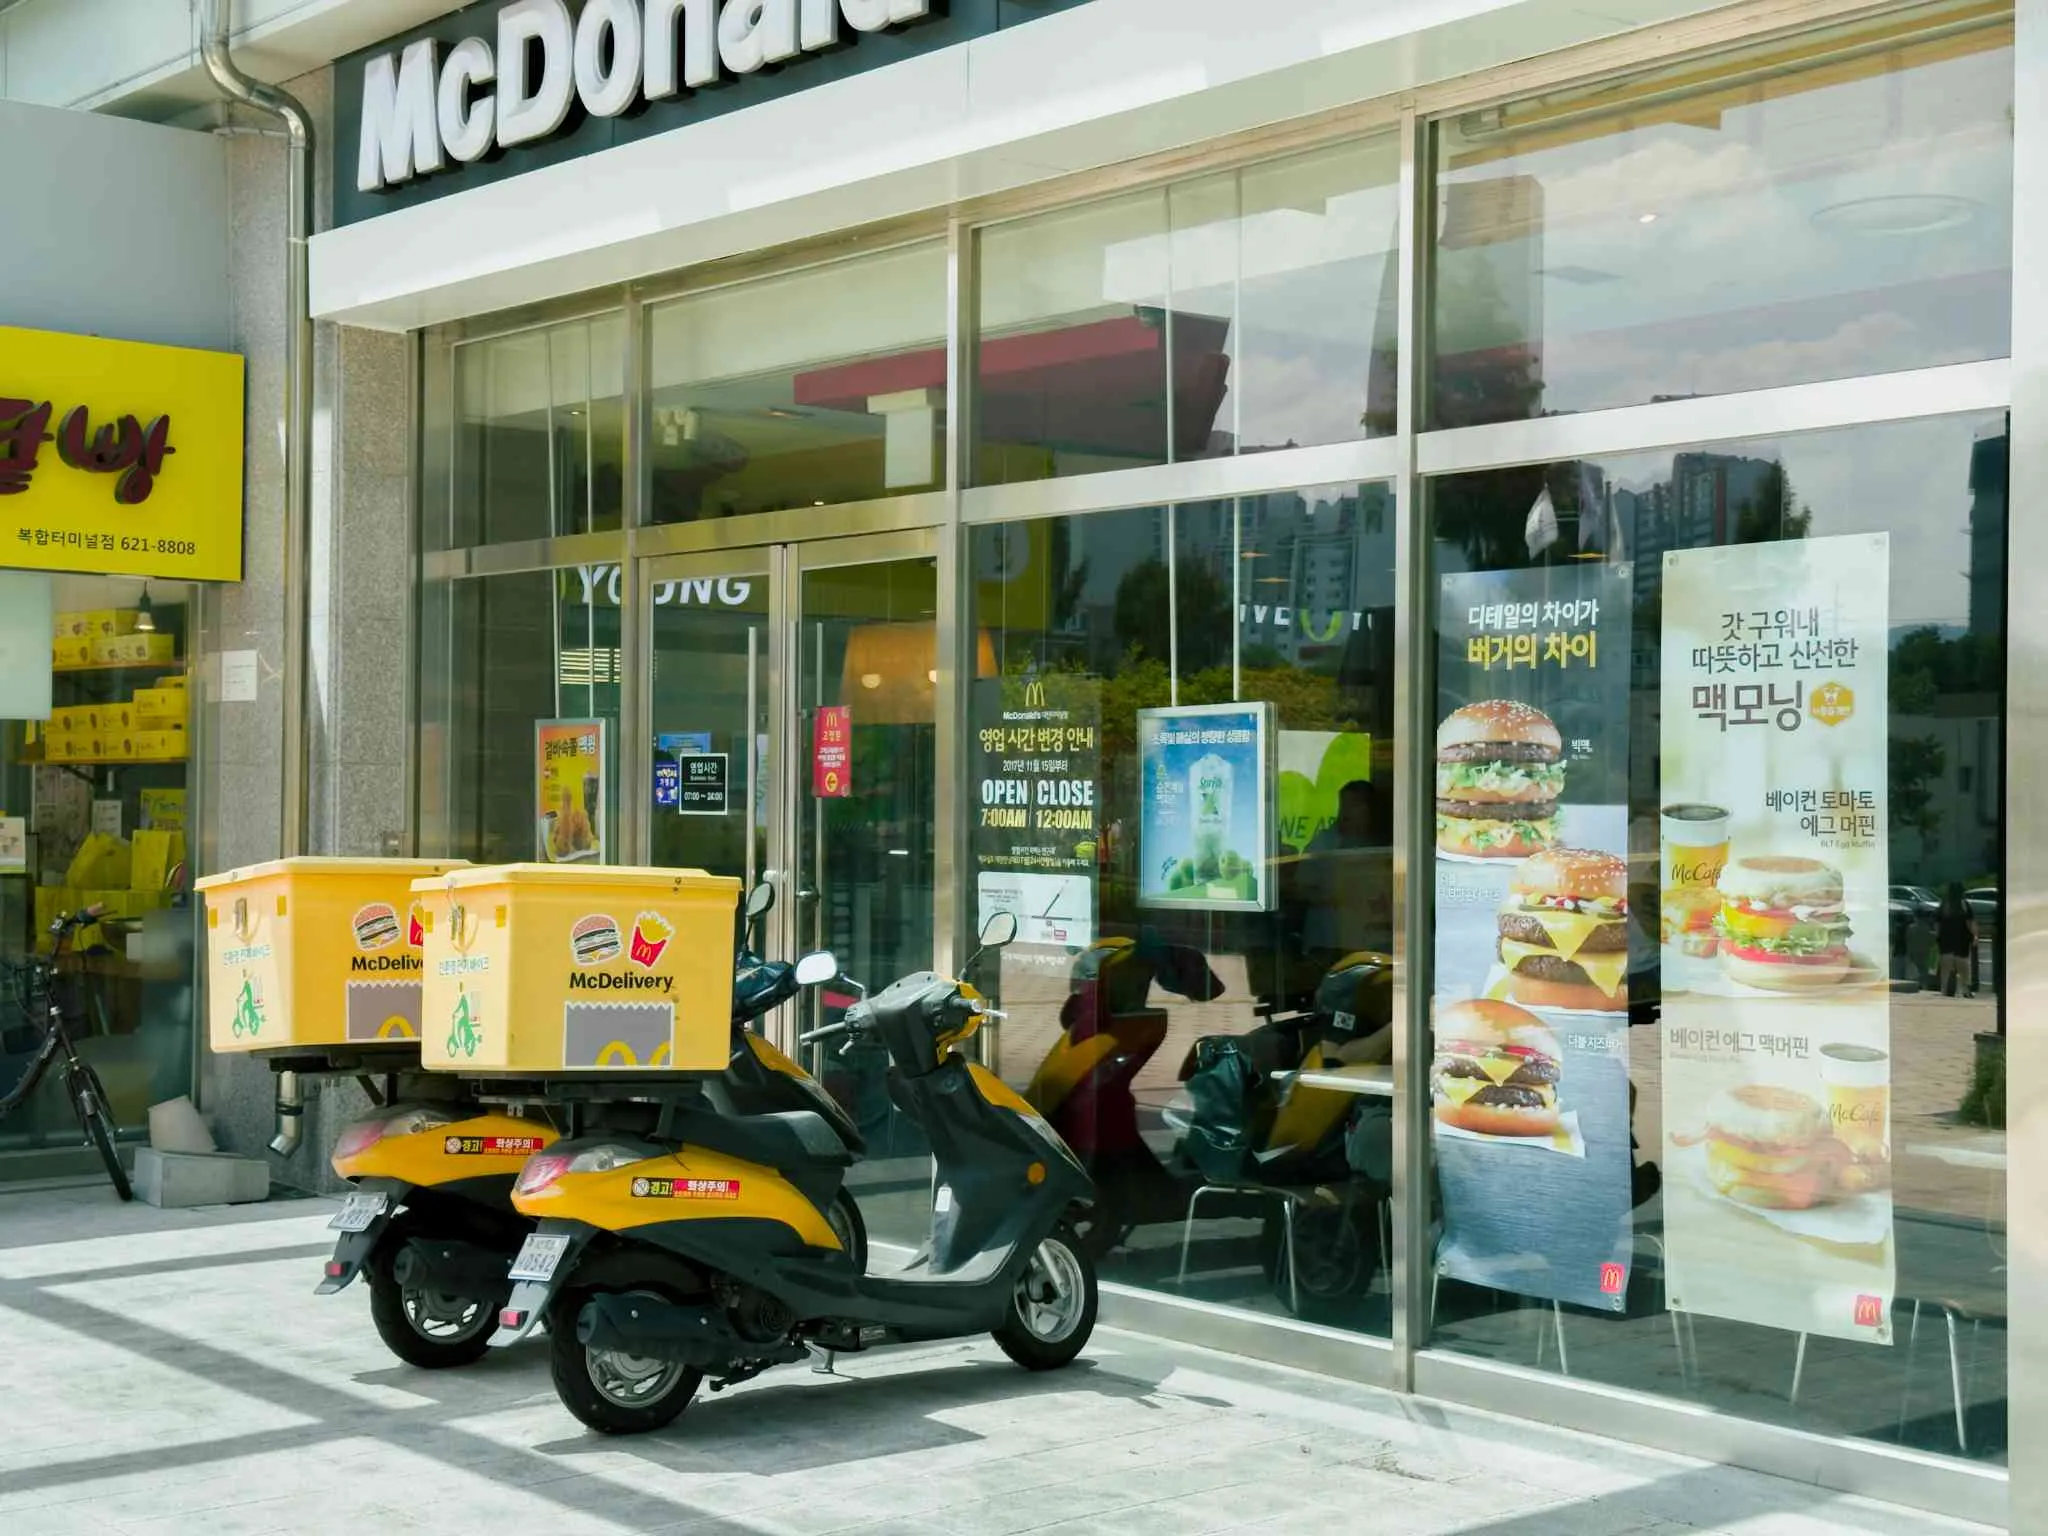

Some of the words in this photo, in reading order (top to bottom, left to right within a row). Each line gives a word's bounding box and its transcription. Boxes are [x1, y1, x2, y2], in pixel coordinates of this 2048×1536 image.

[358, 0, 932, 192] McDona
[17, 527, 115, 550] 복합터미널점
[120, 535, 196, 555] 621-8808
[1468, 601, 1539, 630] 디테일의
[1541, 598, 1600, 628] 차이가
[1721, 611, 1745, 642] 갓
[1748, 605, 1819, 640] 구워내
[1467, 633, 1537, 671] 버거의
[1543, 630, 1597, 669] 차이
[1692, 642, 1783, 674] 따뜻하고
[1789, 637, 1859, 670] 신선한
[1692, 680, 1803, 732] 맥모닝
[979, 727, 1005, 753] 영업
[1008, 727, 1035, 752] 시간
[1037, 727, 1064, 753] 변경
[1067, 727, 1094, 752] 안내
[981, 779, 1028, 805] OPEN
[1037, 779, 1094, 806] CLOSE
[1765, 789, 1817, 812] 베이컨
[1819, 789, 1876, 812] 토마토
[981, 808, 1027, 828] 7:00AM
[1036, 809, 1093, 830] 12:00AM
[1800, 814, 1836, 837] 에그
[1840, 814, 1875, 837] 머핀
[351, 955, 423, 972] McDeliv
[569, 972, 674, 993] McDelivery
[1670, 1028, 1720, 1051] 베이컨
[1723, 1030, 1756, 1053] 에그
[1758, 1033, 1810, 1060] 맥머핀
